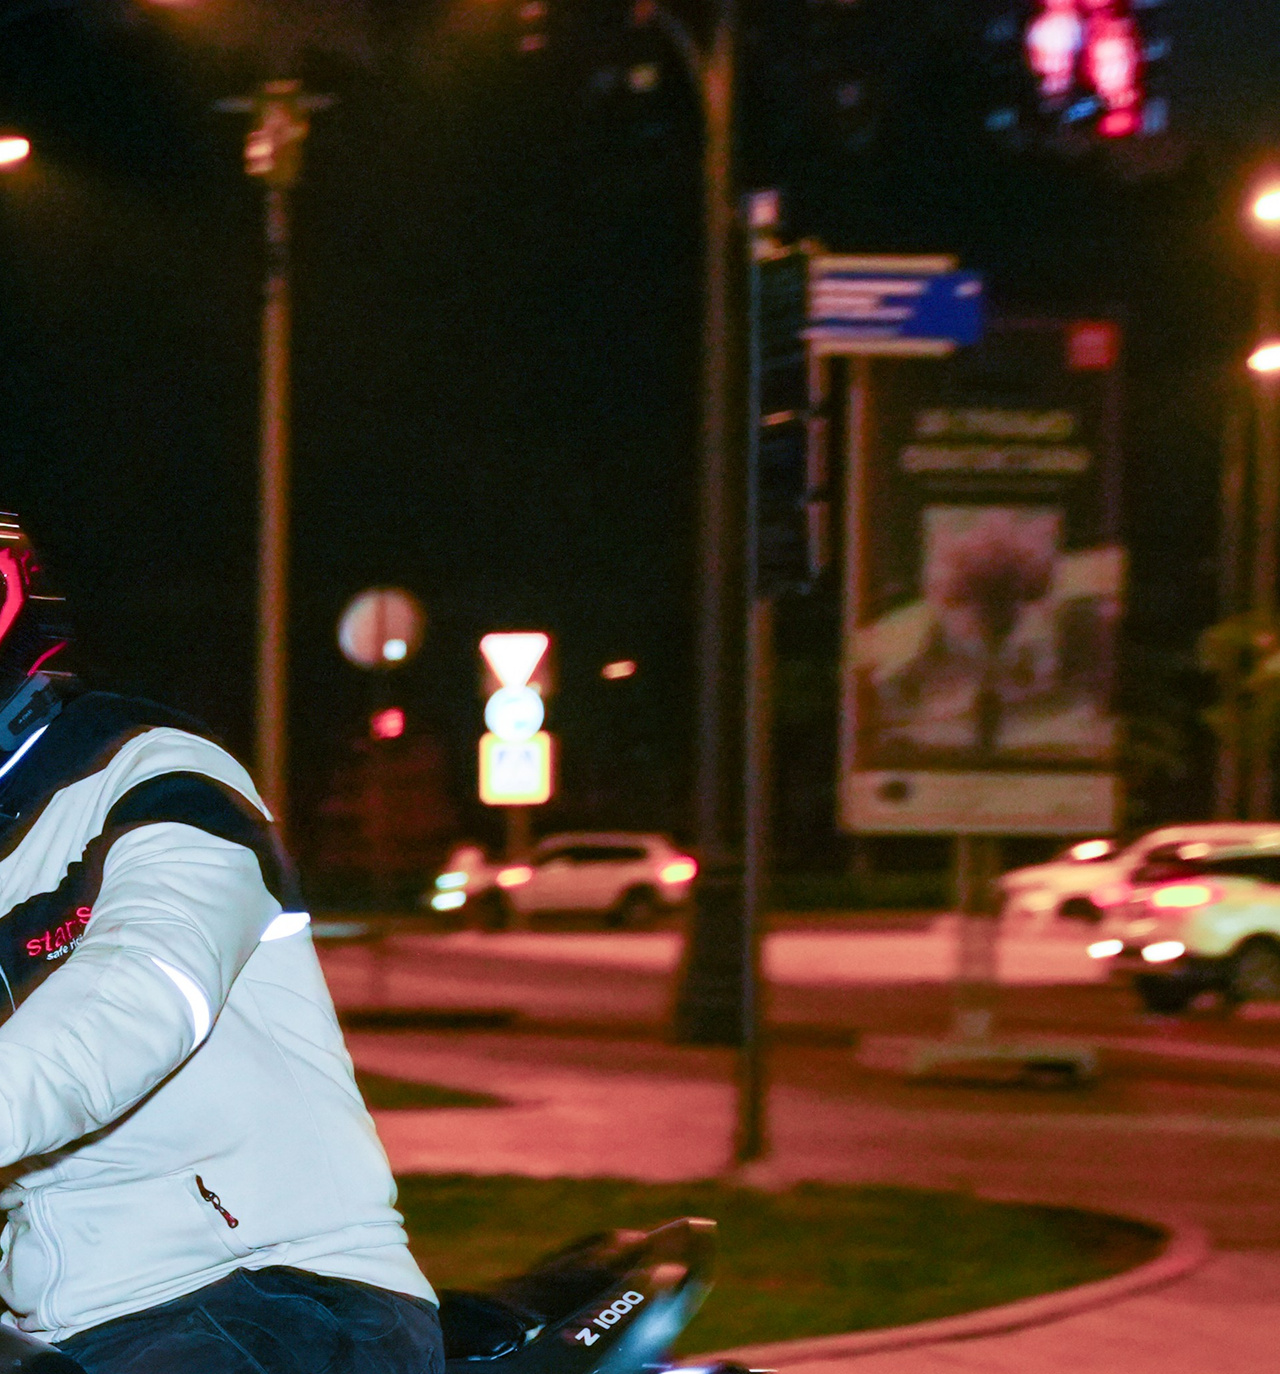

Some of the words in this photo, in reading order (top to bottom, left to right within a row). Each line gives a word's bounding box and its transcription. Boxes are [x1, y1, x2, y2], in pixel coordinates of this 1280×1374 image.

[46, 945, 69, 960] safe
[574, 1327, 600, 1346] Z
[592, 1290, 644, 1330] 1000
